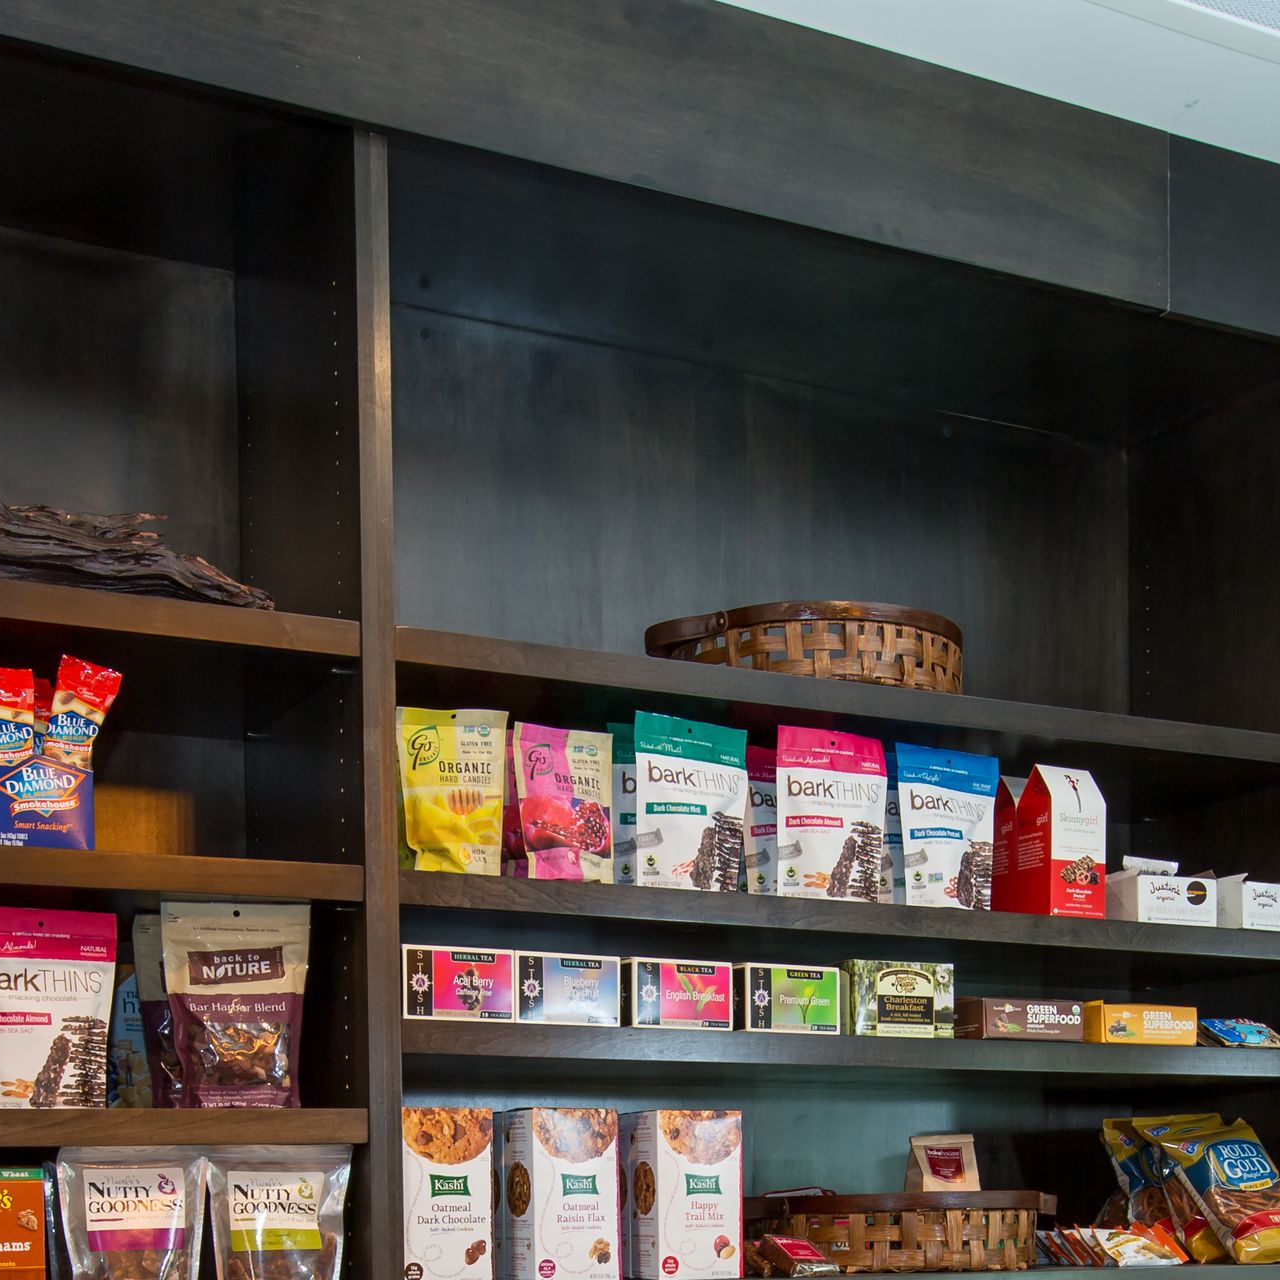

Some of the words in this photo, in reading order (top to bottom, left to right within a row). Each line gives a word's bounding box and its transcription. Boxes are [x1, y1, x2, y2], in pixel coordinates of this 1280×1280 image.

[58, 714, 86, 727] BLUE
[439, 761, 492, 775] ORGANIC
[22, 767, 58, 781] BLUE
[5, 775, 75, 793] DIAMOND
[440, 776, 458, 784] HARD
[463, 775, 491, 785] CANDIES
[214, 955, 242, 964] back
[665, 990, 692, 1001] English
[693, 991, 725, 1003] Breakfast
[884, 996, 927, 1005] Charleston
[189, 1003, 209, 1011] Bar
[212, 998, 251, 1013] Harbor
[255, 1001, 286, 1012] Blend
[886, 1004, 926, 1012] Breakfast
[1026, 1005, 1057, 1015] GREEN
[26, 1015, 49, 1023] Almond
[1026, 1014, 1081, 1024] SUPERFOOD
[1143, 1010, 1171, 1021] GREEN
[1143, 1020, 1195, 1031] SUPERFOOD
[1217, 1145, 1257, 1158] ROLD
[1223, 1158, 1270, 1179] GOLD
[434, 1179, 464, 1190] Kashi
[566, 1179, 592, 1189] Kashi
[689, 1178, 716, 1189] Kashi
[89, 1199, 184, 1214] GOODNESS
[233, 1202, 317, 1214] GOODNESS
[431, 1203, 472, 1212] Oatmeal
[563, 1202, 599, 1211] Oatmeal
[691, 1202, 718, 1211] Happy
[417, 1215, 439, 1225] Dark
[442, 1214, 486, 1224] Chocolate
[557, 1214, 585, 1223] Raisin
[588, 1213, 606, 1222] Flax
[685, 1213, 705, 1221] Trail
